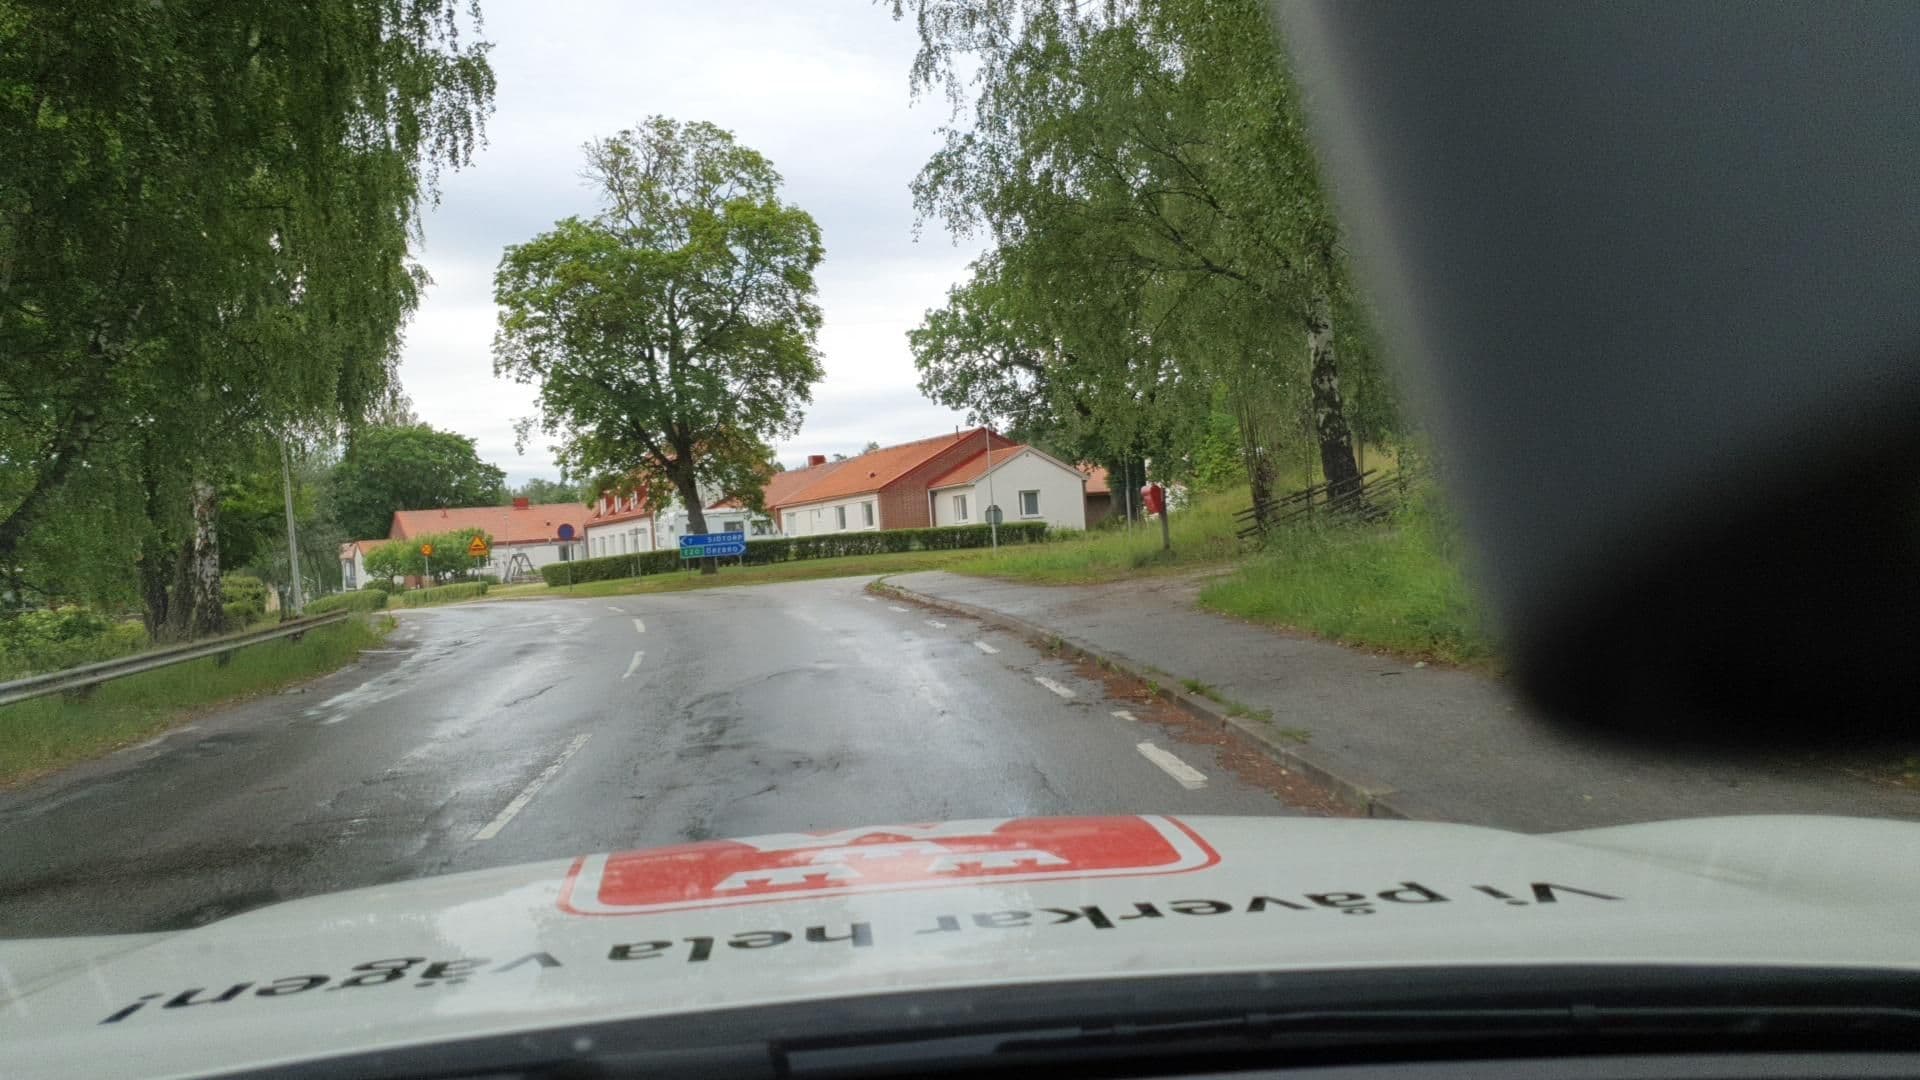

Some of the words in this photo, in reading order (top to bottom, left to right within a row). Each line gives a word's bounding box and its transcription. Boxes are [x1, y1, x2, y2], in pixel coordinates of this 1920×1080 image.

[684, 548, 701, 556] E20
[706, 545, 738, 554] ÖREBRO
[914, 881, 1452, 935] påverkar
[1470, 881, 1624, 906] Vi
[607, 922, 873, 963] hela
[98, 951, 562, 1026] vägen!
